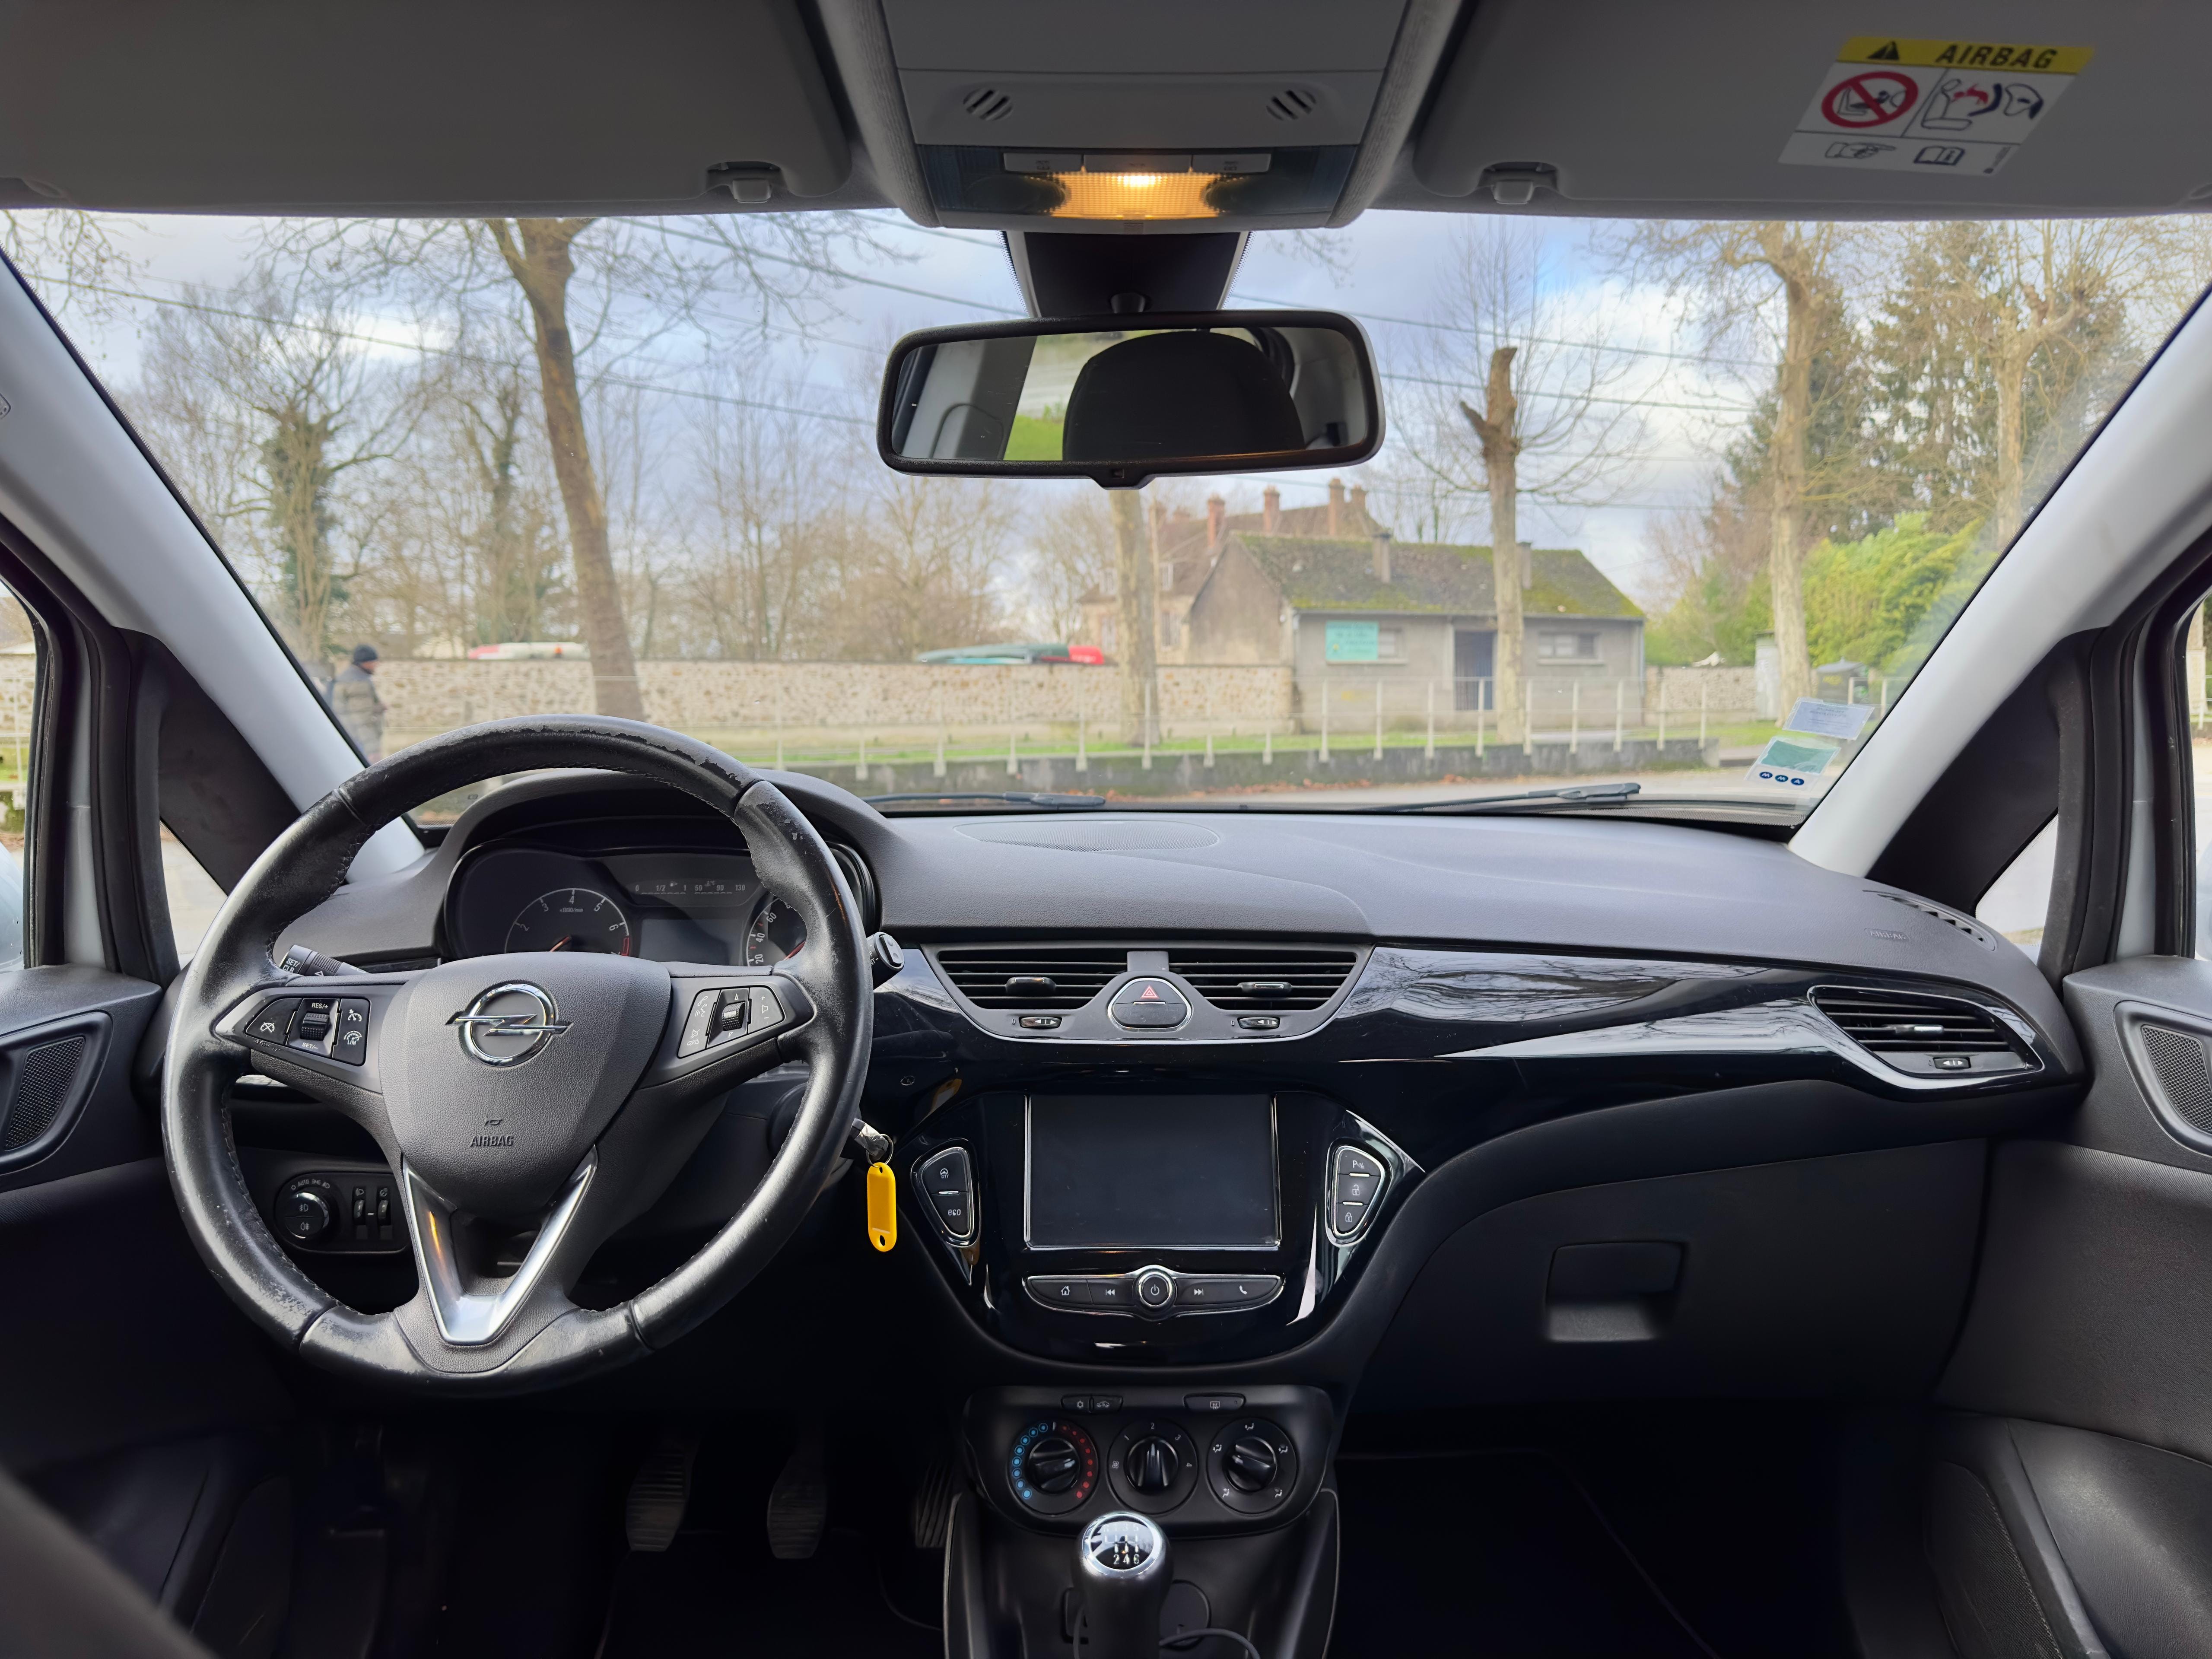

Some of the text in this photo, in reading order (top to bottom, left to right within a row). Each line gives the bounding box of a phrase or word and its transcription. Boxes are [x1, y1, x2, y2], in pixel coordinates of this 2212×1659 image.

[1935, 44, 2058, 69] AIRBAG
[569, 895, 574, 904] 4
[541, 903, 549, 912] 3
[594, 903, 602, 912] 5
[766, 912, 777, 923] 60
[756, 932, 765, 943] 40
[1870, 930, 1906, 940] AIRBAG
[286, 958, 301, 967] SET/
[755, 953, 764, 964] 20
[283, 964, 295, 973] CLR
[470, 1135, 515, 1147] AIRBAG
[1113, 1554, 1139, 1564] 2 4 6
